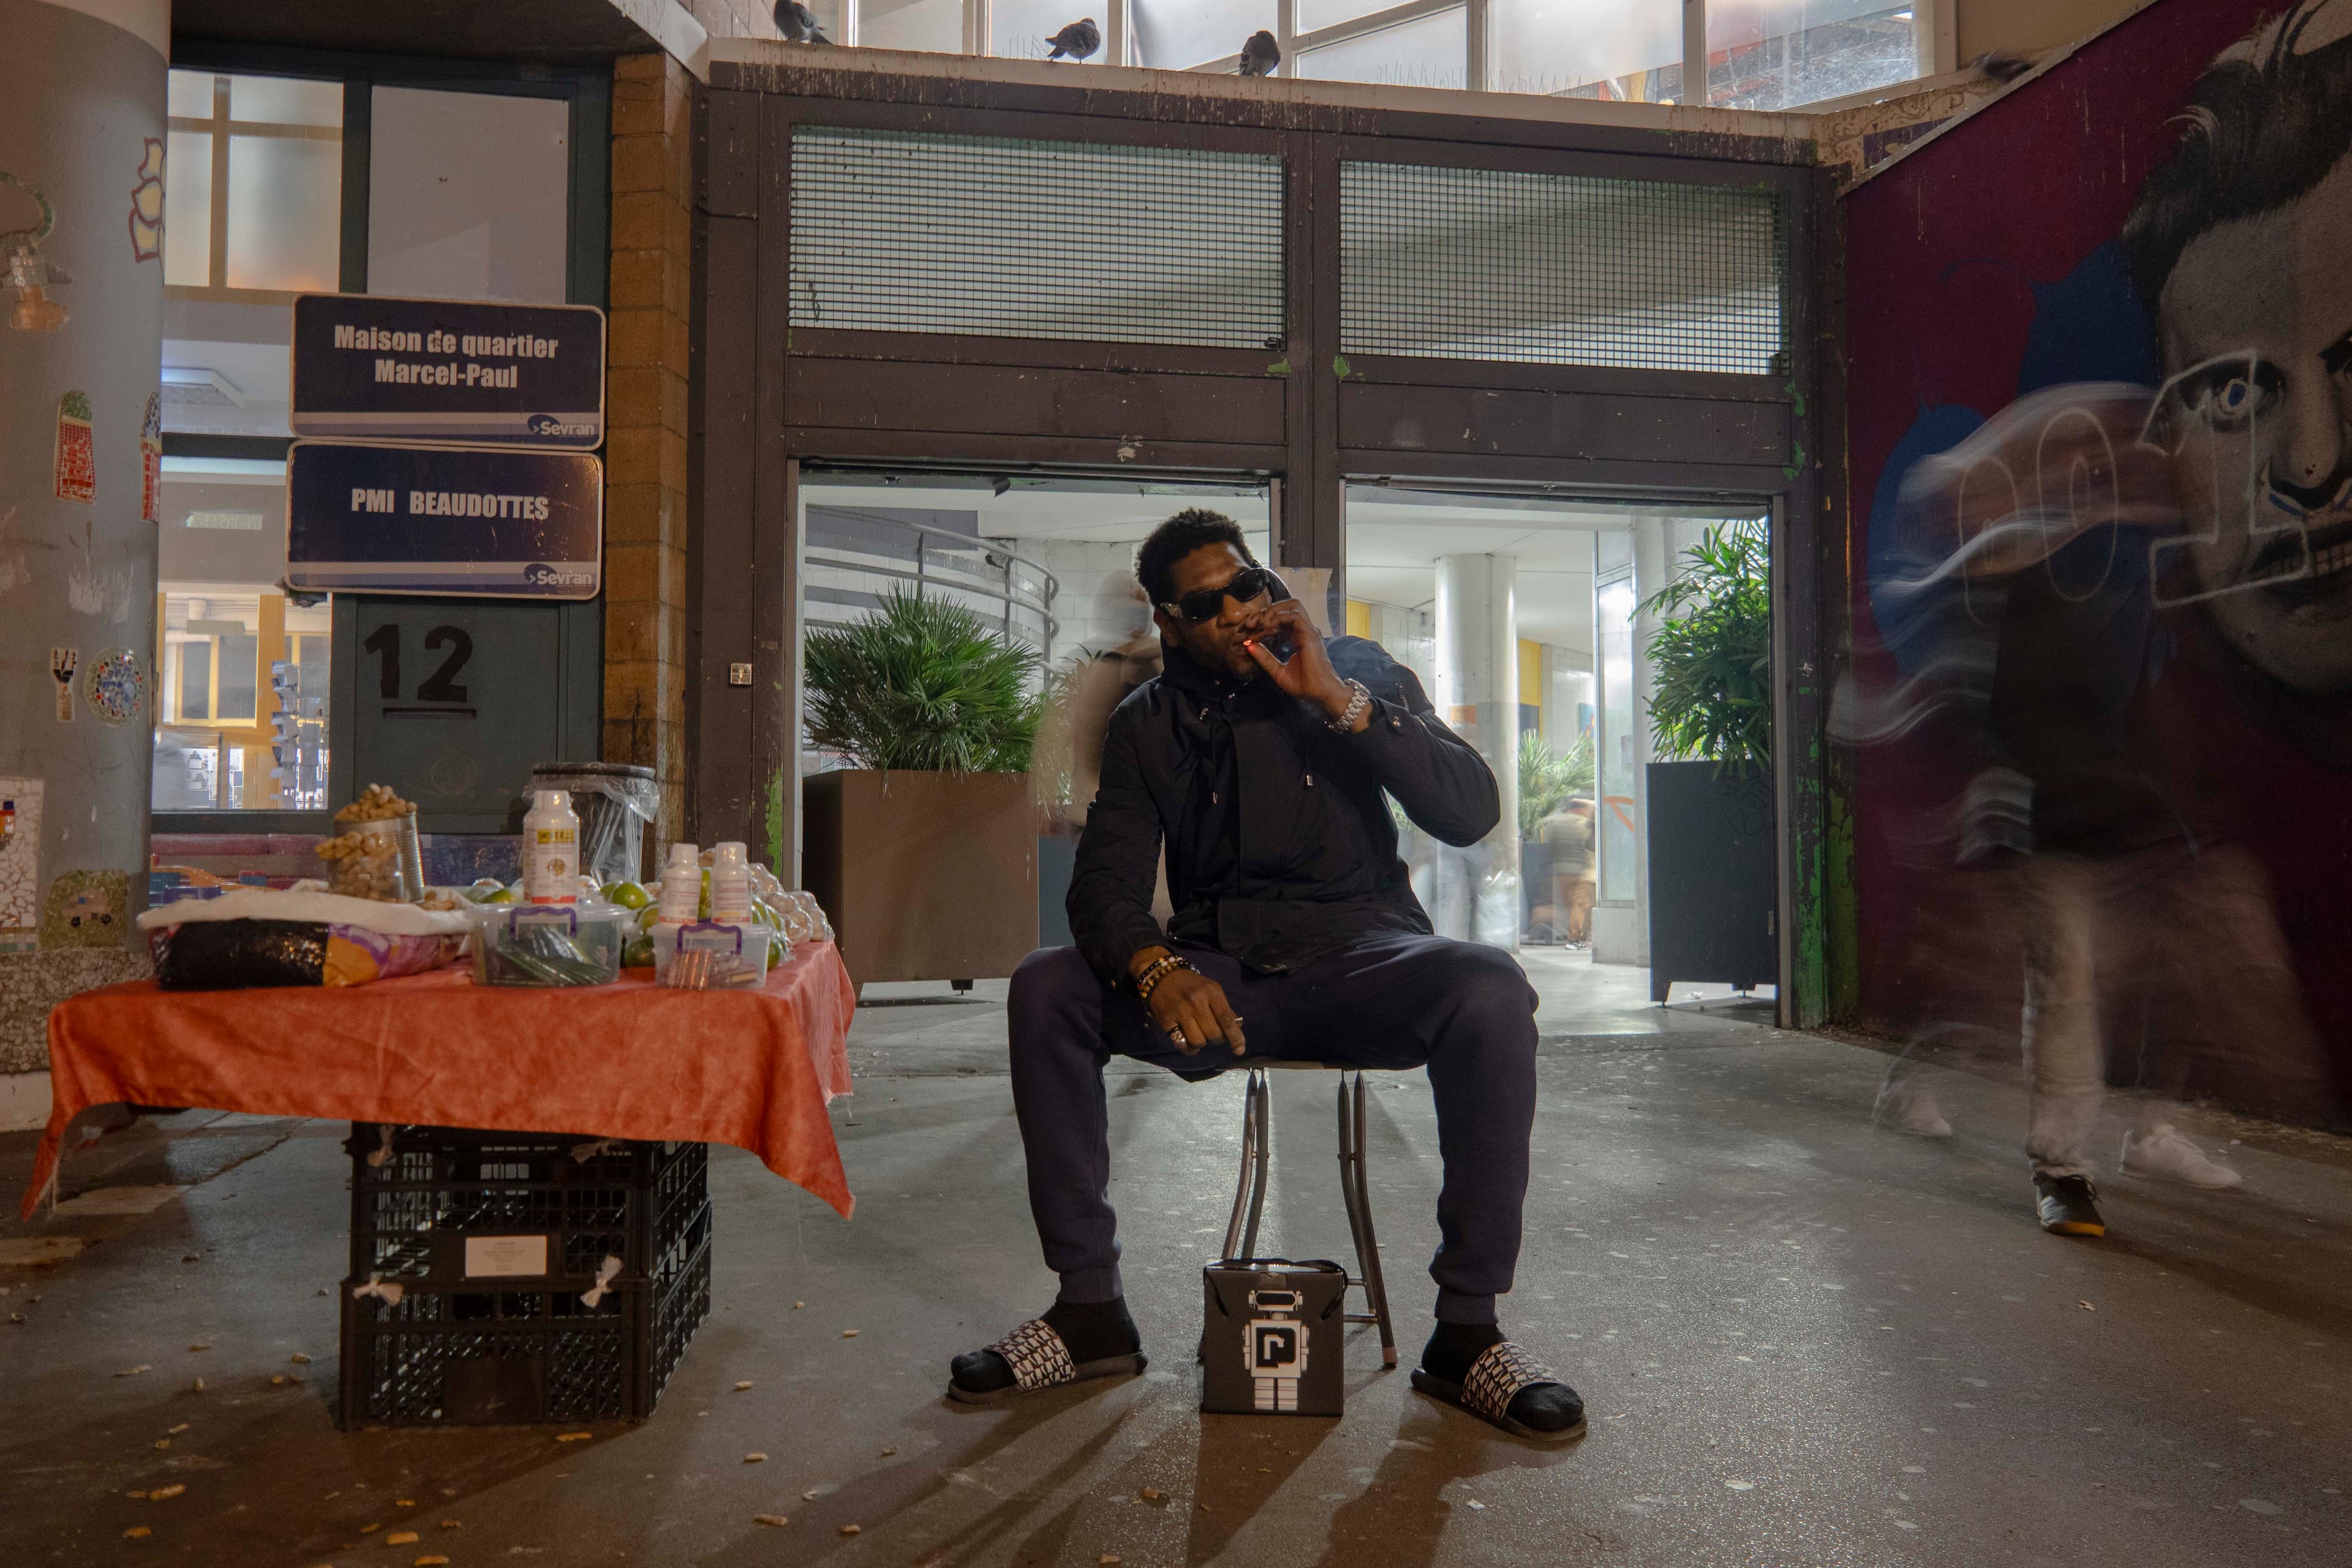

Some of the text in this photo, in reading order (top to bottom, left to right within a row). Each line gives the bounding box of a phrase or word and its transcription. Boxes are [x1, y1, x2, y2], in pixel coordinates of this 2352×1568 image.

[334, 325, 559, 359] Maison de quartier
[375, 360, 518, 388] Marcel-Paul
[540, 420, 594, 435] Sevran
[352, 488, 549, 519] PMI BEAUDOTTES
[537, 570, 592, 586] Sevran
[364, 624, 473, 703] 12
